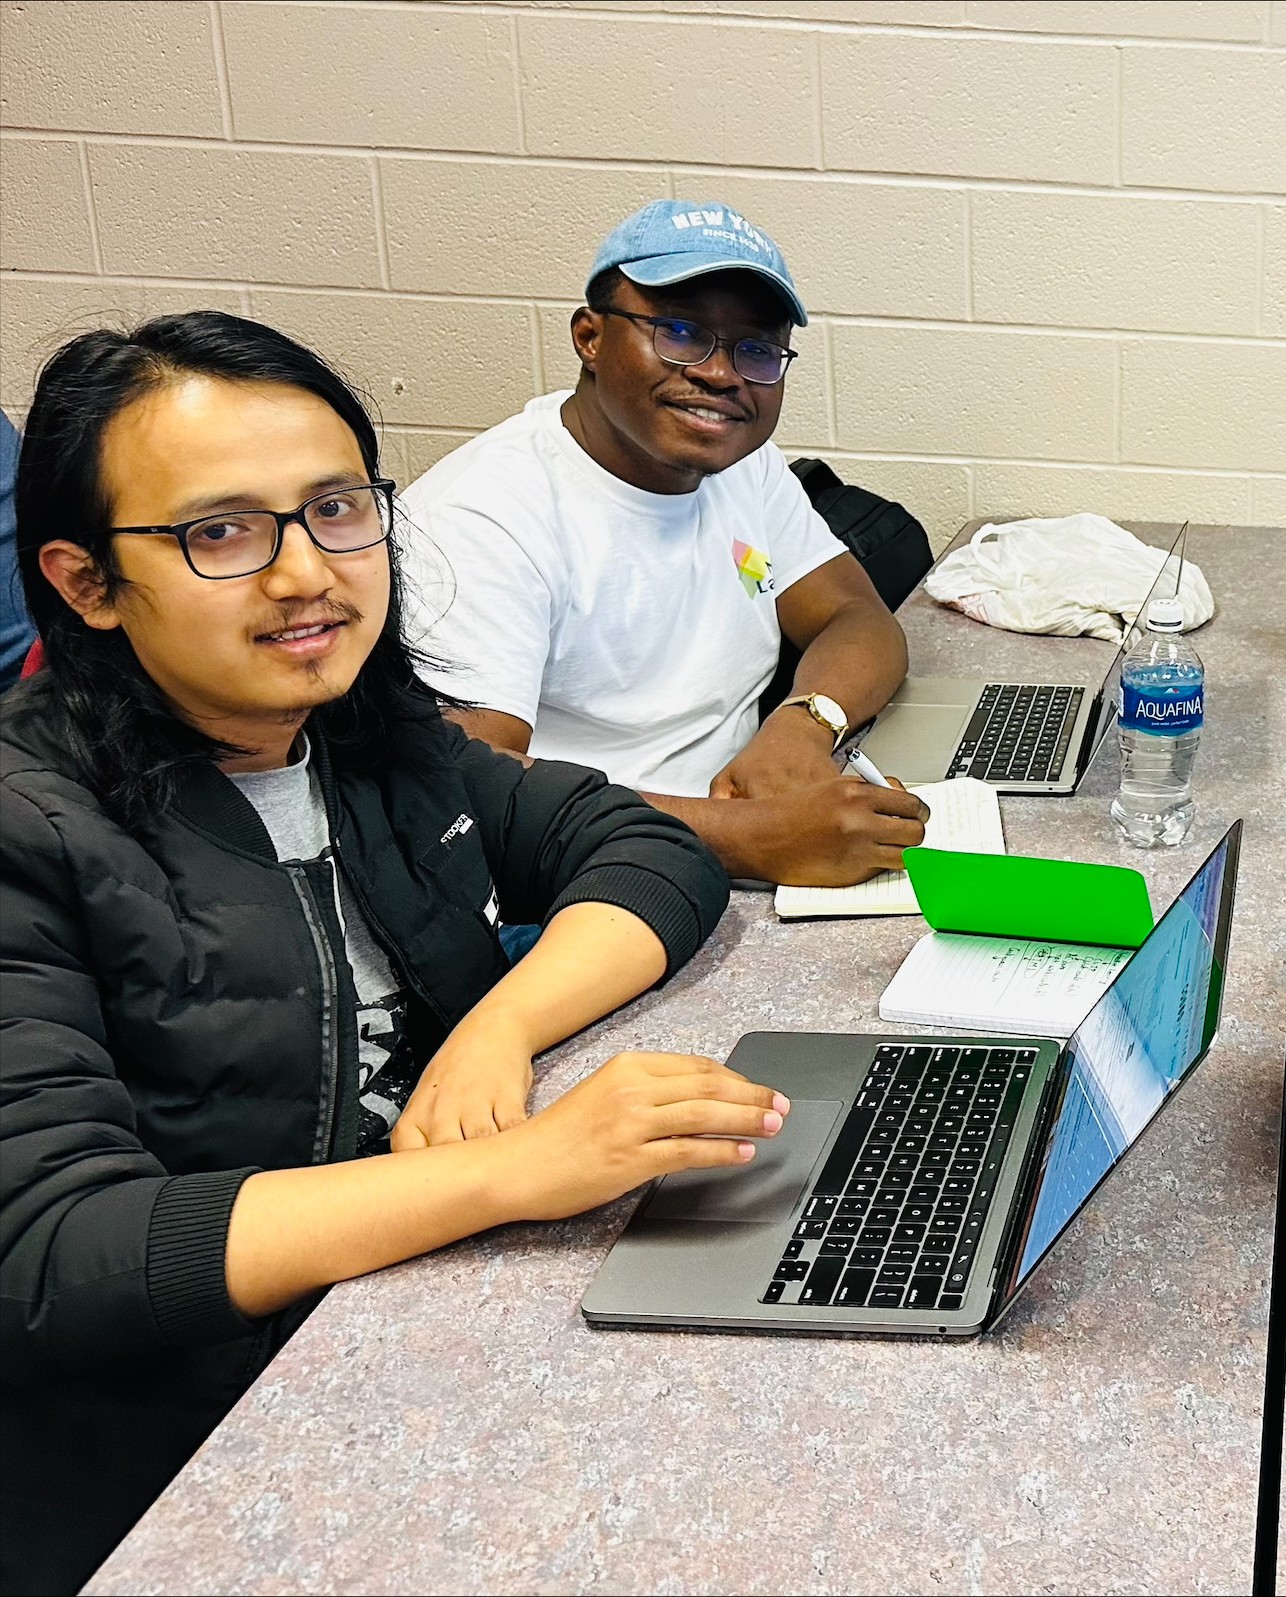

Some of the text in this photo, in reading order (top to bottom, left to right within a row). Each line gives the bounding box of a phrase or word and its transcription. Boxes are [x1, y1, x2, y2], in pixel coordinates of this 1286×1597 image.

[671, 210, 723, 230] NEW
[702, 228, 736, 241] SINCE
[1135, 696, 1203, 721] AQUAFINA
